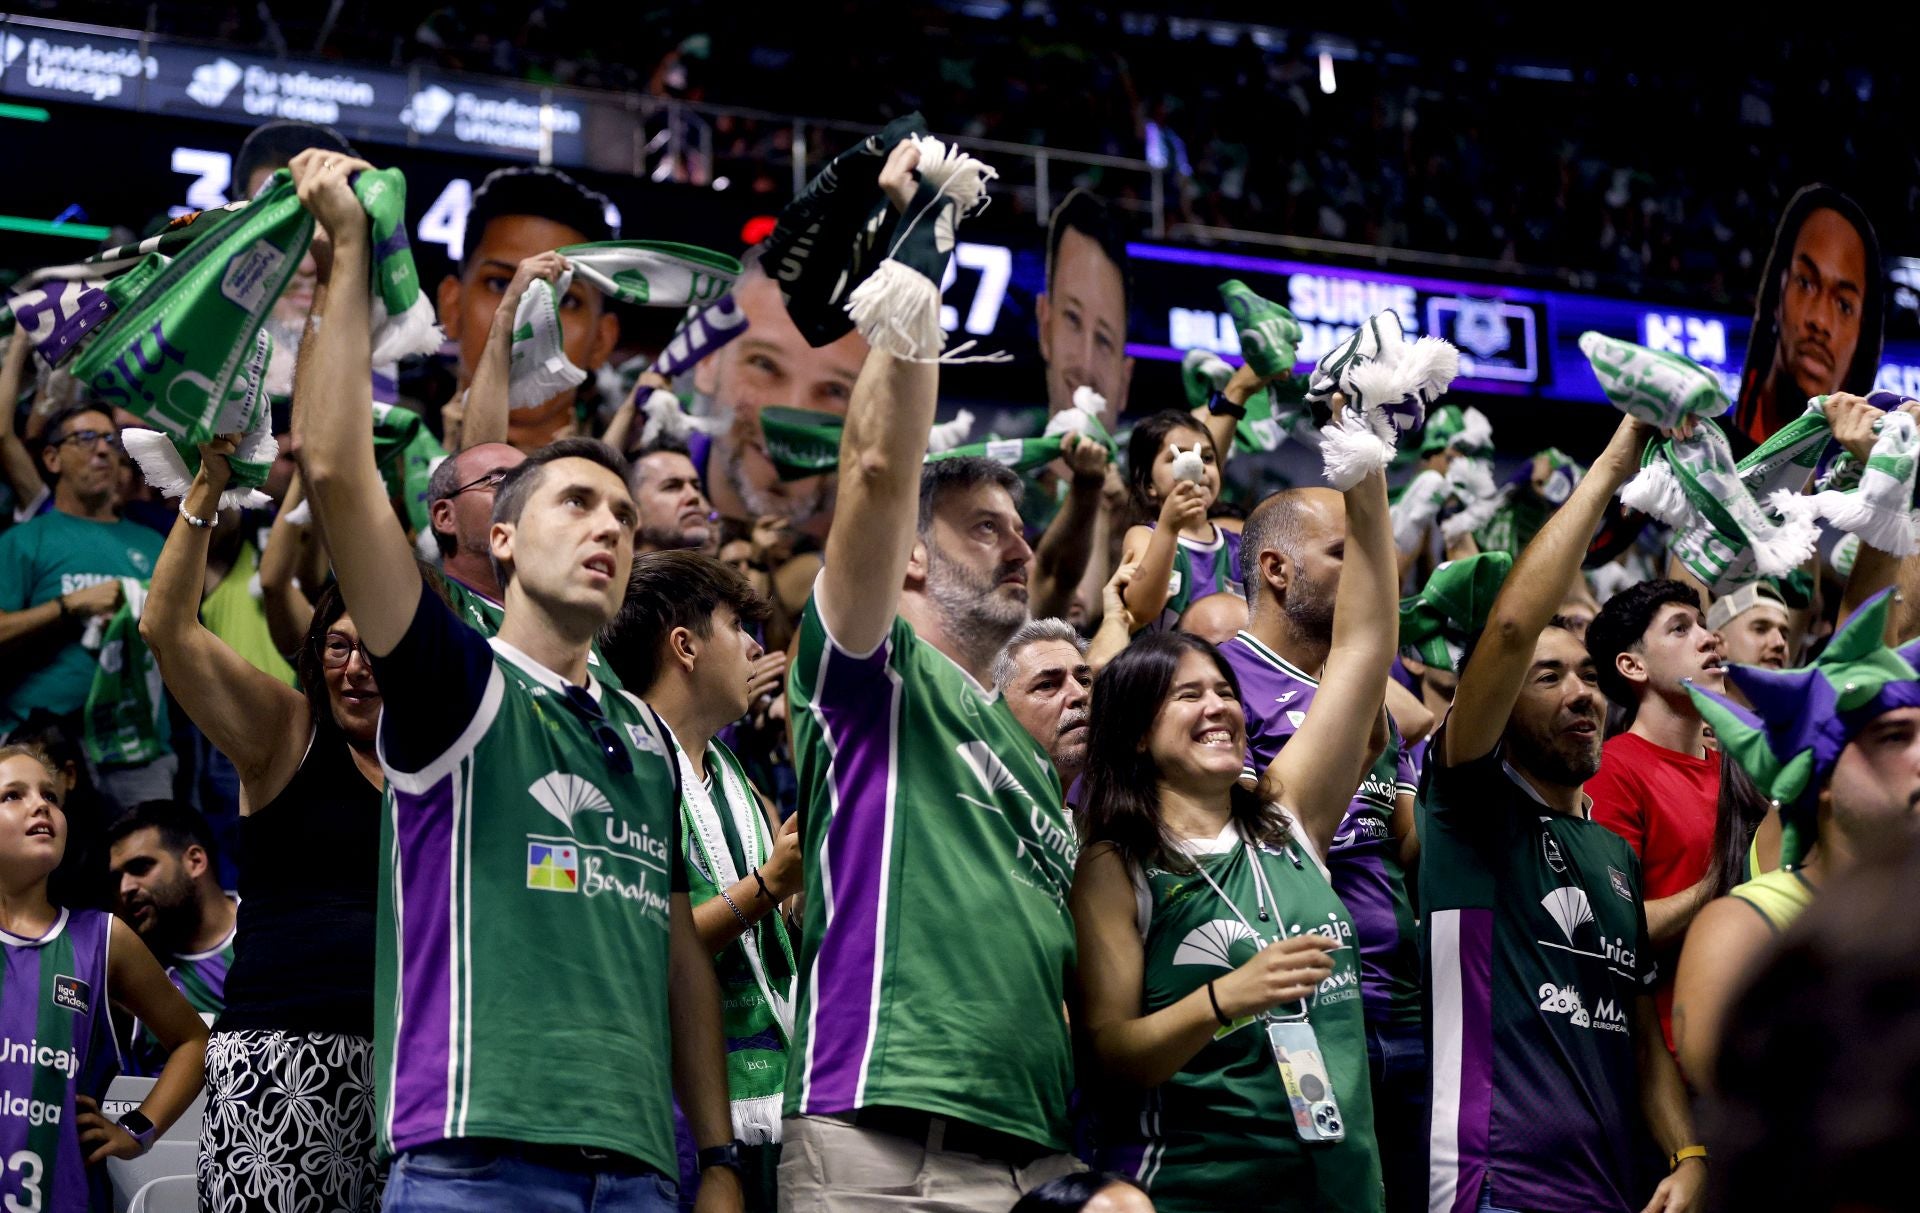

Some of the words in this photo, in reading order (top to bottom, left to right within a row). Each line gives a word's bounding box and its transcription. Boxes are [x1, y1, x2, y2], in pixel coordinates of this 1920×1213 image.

[606, 816, 668, 862] Unica
[58, 984, 76, 997] liga
[57, 994, 89, 1010] endesa
[746, 1060, 773, 1071] BCL
